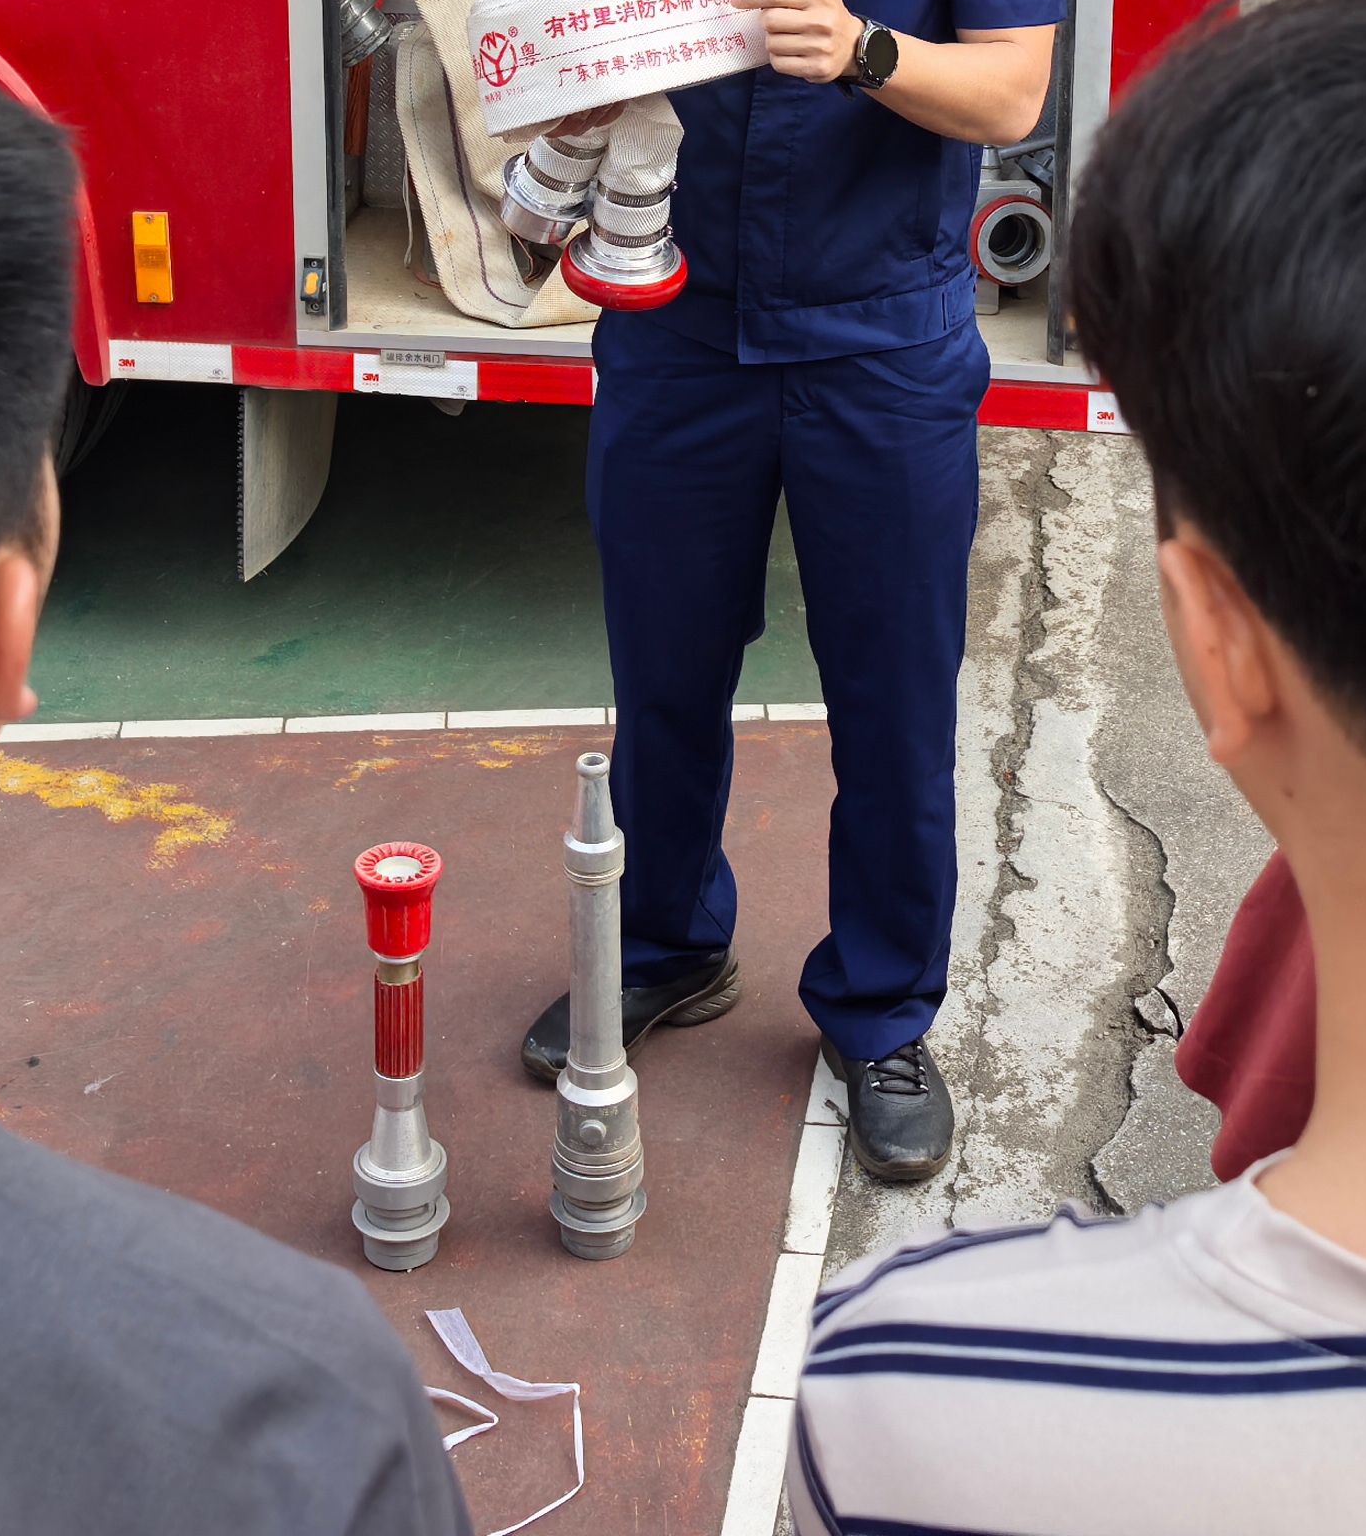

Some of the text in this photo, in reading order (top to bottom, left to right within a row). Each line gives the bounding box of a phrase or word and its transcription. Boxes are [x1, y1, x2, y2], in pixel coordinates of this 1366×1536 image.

[557, 31, 747, 88] 广东南粤消防设备有限公司
[118, 358, 135, 368] 3M
[362, 372, 380, 382] 3M
[1096, 411, 1115, 421] 3M
